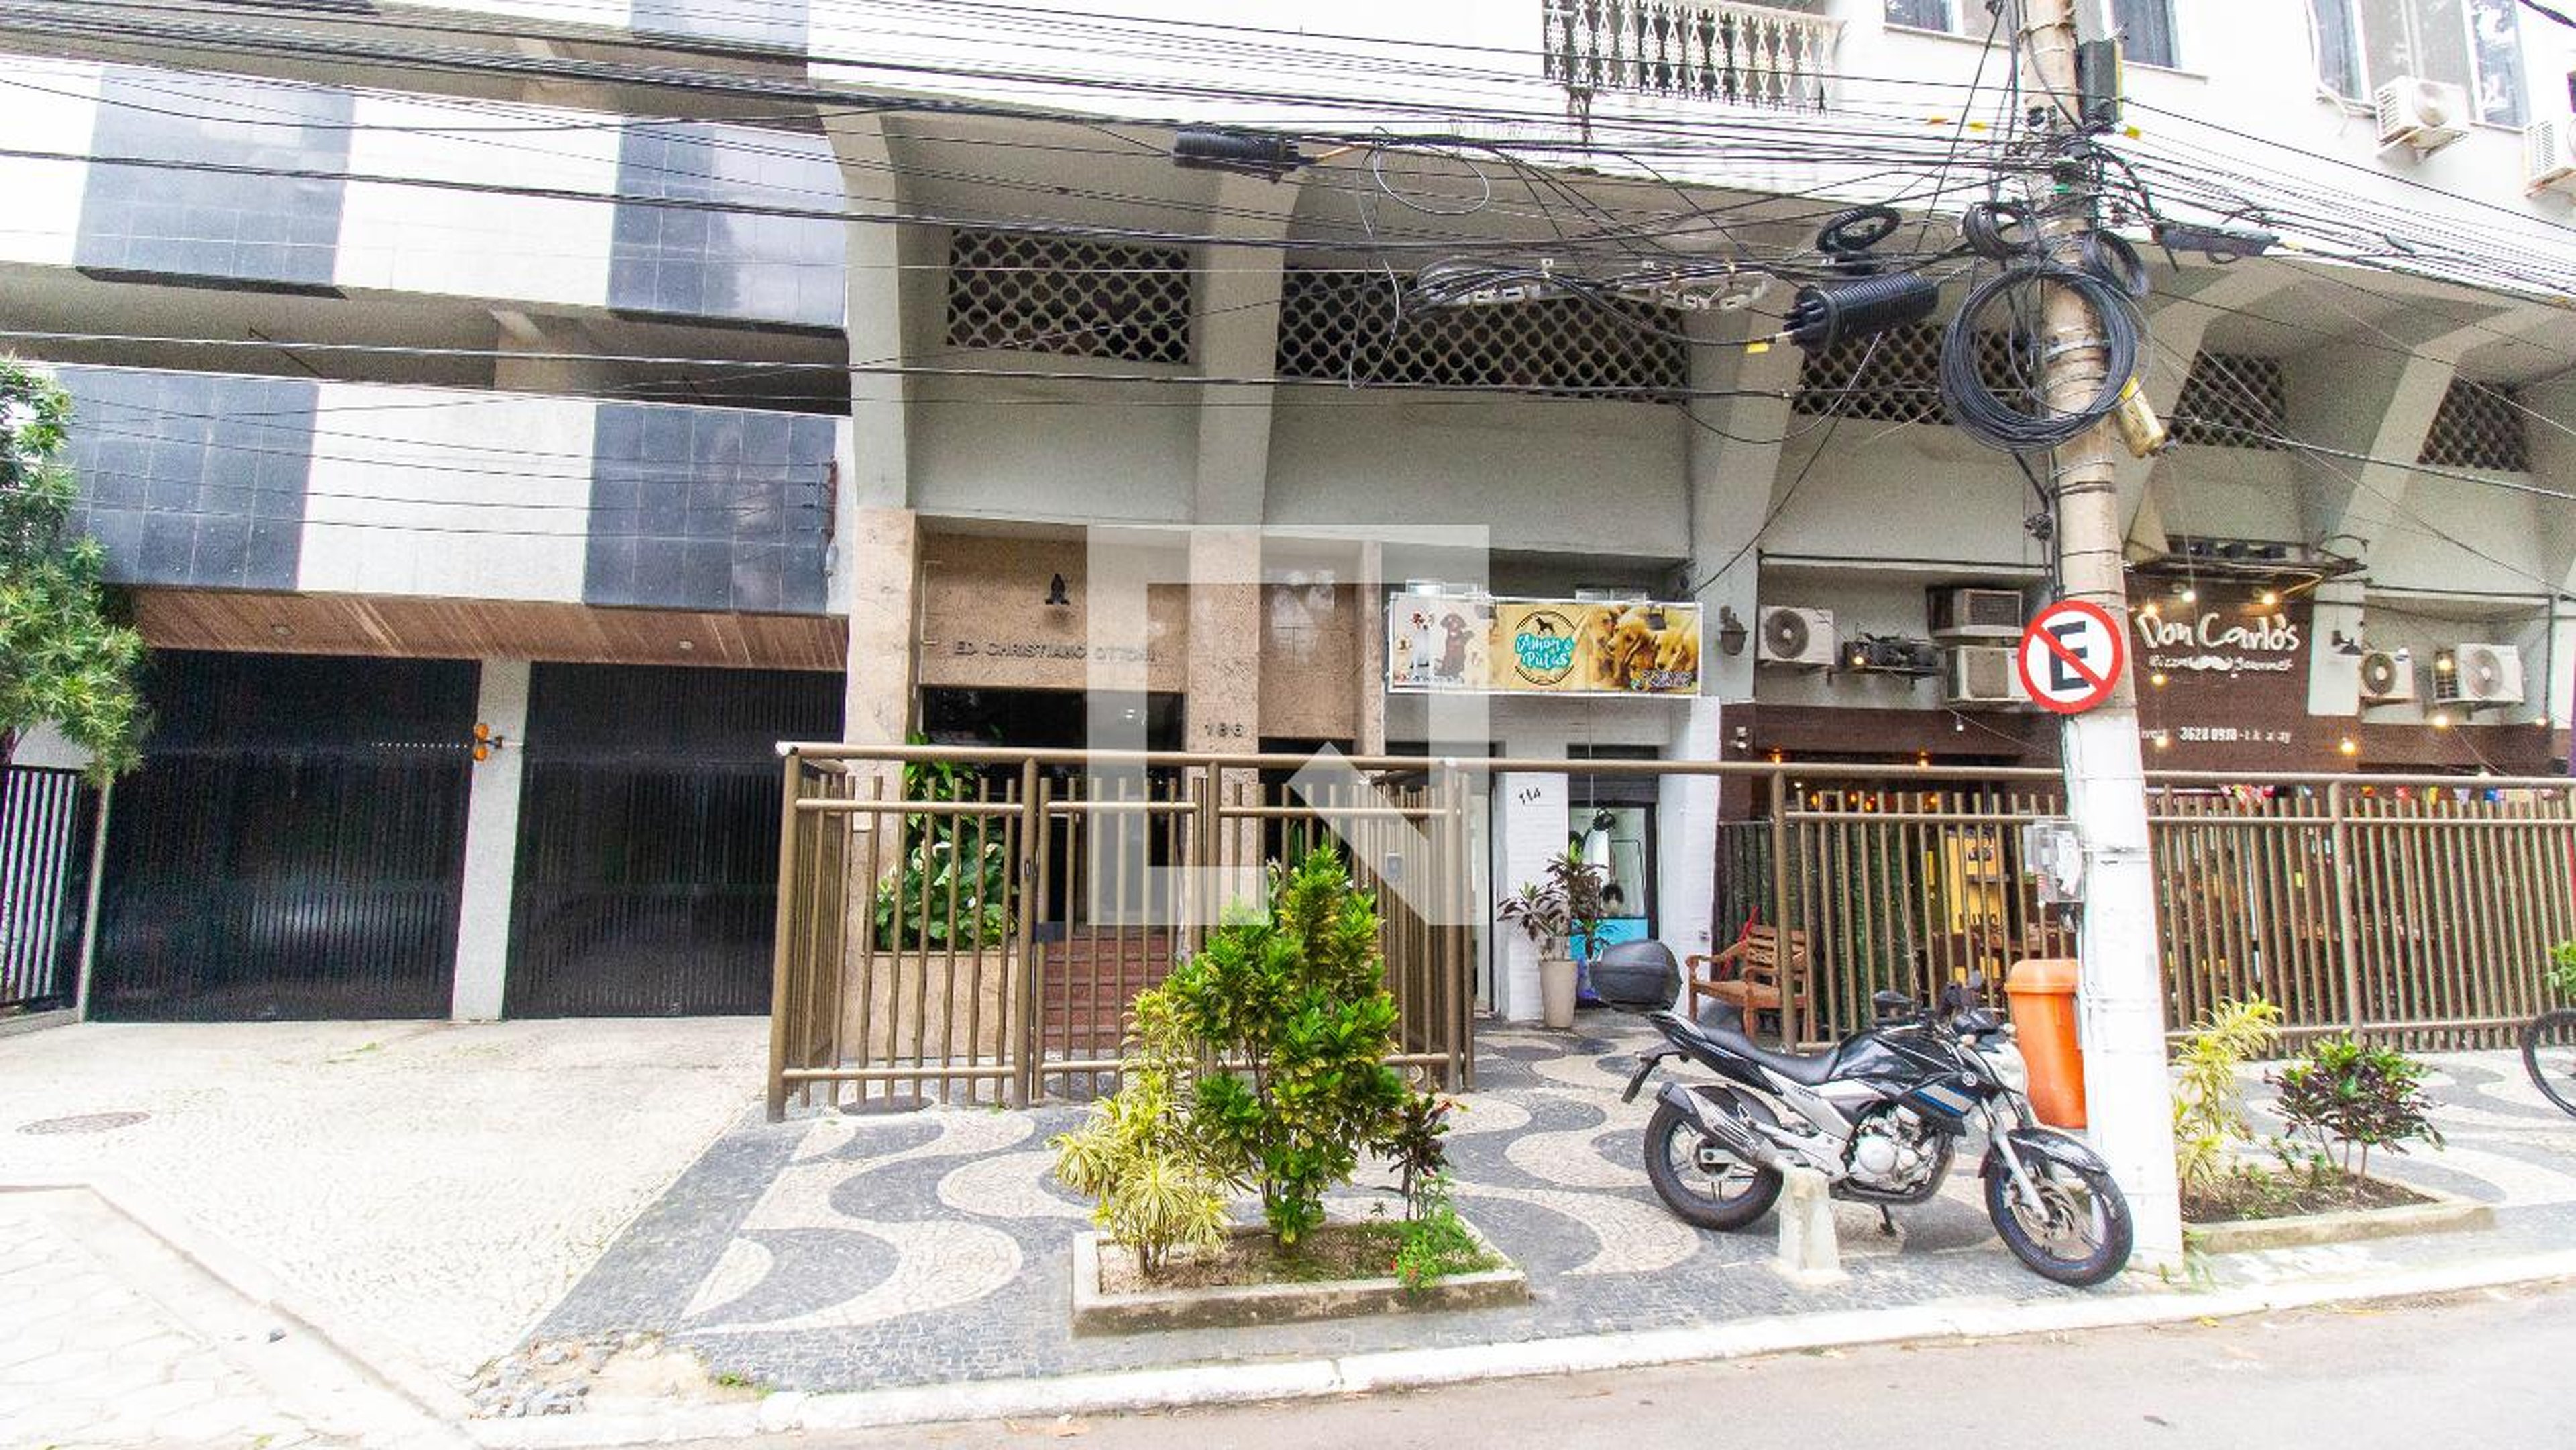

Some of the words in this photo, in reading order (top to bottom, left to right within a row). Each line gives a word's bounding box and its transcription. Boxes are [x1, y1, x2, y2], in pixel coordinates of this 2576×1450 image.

[2048, 620, 2089, 691] E
[2135, 612, 2195, 648] Don
[2198, 612, 2300, 651] Carlo's
